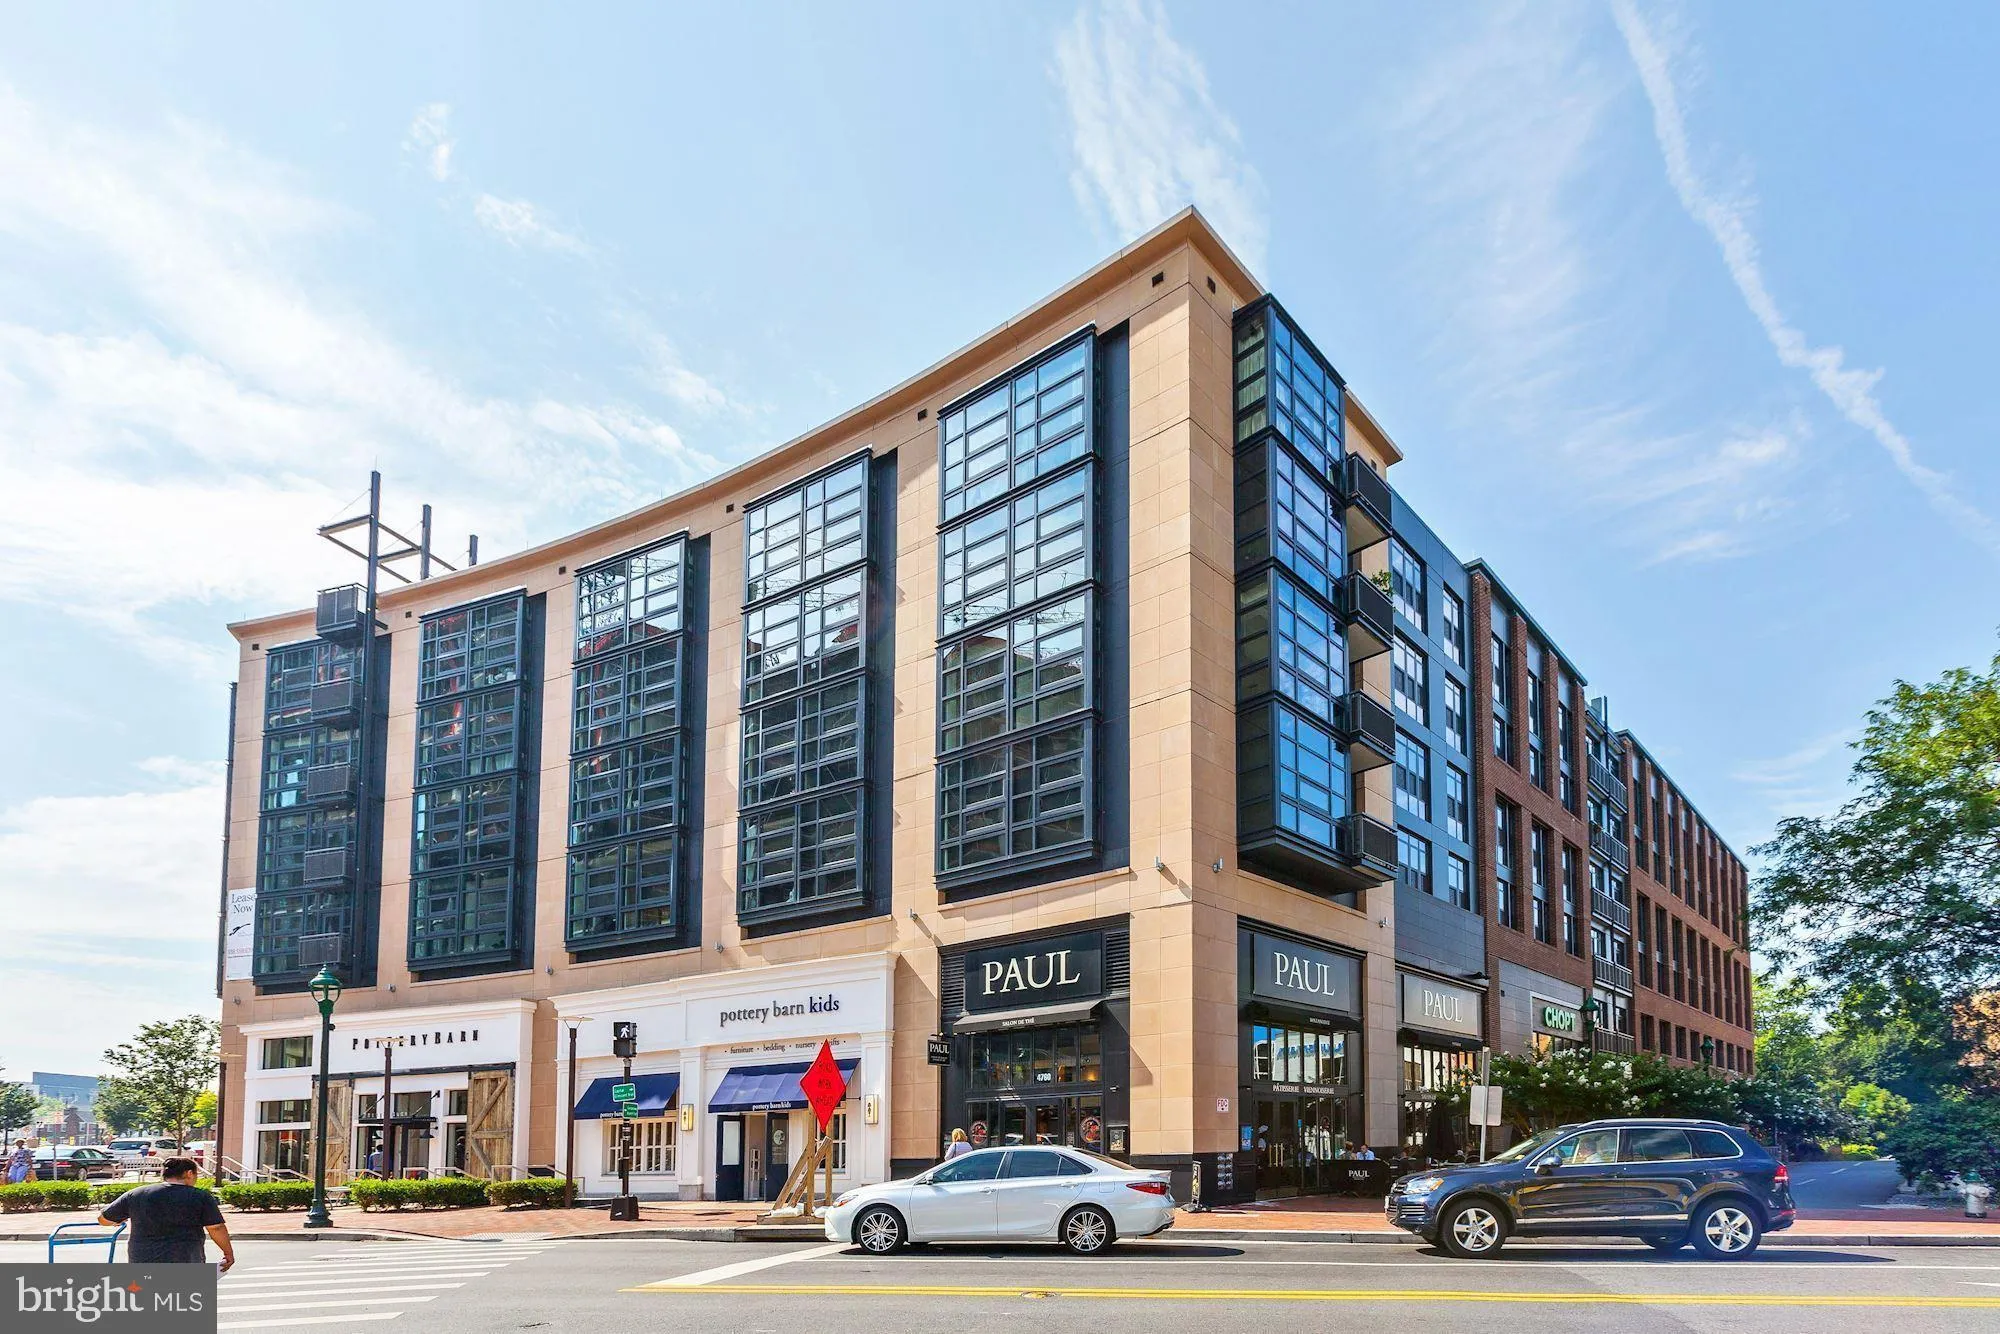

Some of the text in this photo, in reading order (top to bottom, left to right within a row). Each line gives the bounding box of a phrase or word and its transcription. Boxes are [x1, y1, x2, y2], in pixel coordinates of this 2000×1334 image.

[231, 892, 256, 904] Lease
[233, 904, 254, 914] Now
[982, 950, 1080, 995] PAUL
[1273, 951, 1336, 996] PAUL
[720, 994, 840, 1028] pottery barn kids
[1423, 989, 1463, 1023] PAUL
[1001, 1019, 1018, 1027] SALON
[1544, 1006, 1576, 1031] CHOPT
[730, 1037, 840, 1054] furniture bedding nursery ifts
[929, 1043, 950, 1054] PAUL
[1217, 1099, 1228, 1108] FDC
[1348, 1170, 1370, 1178] PAUL
